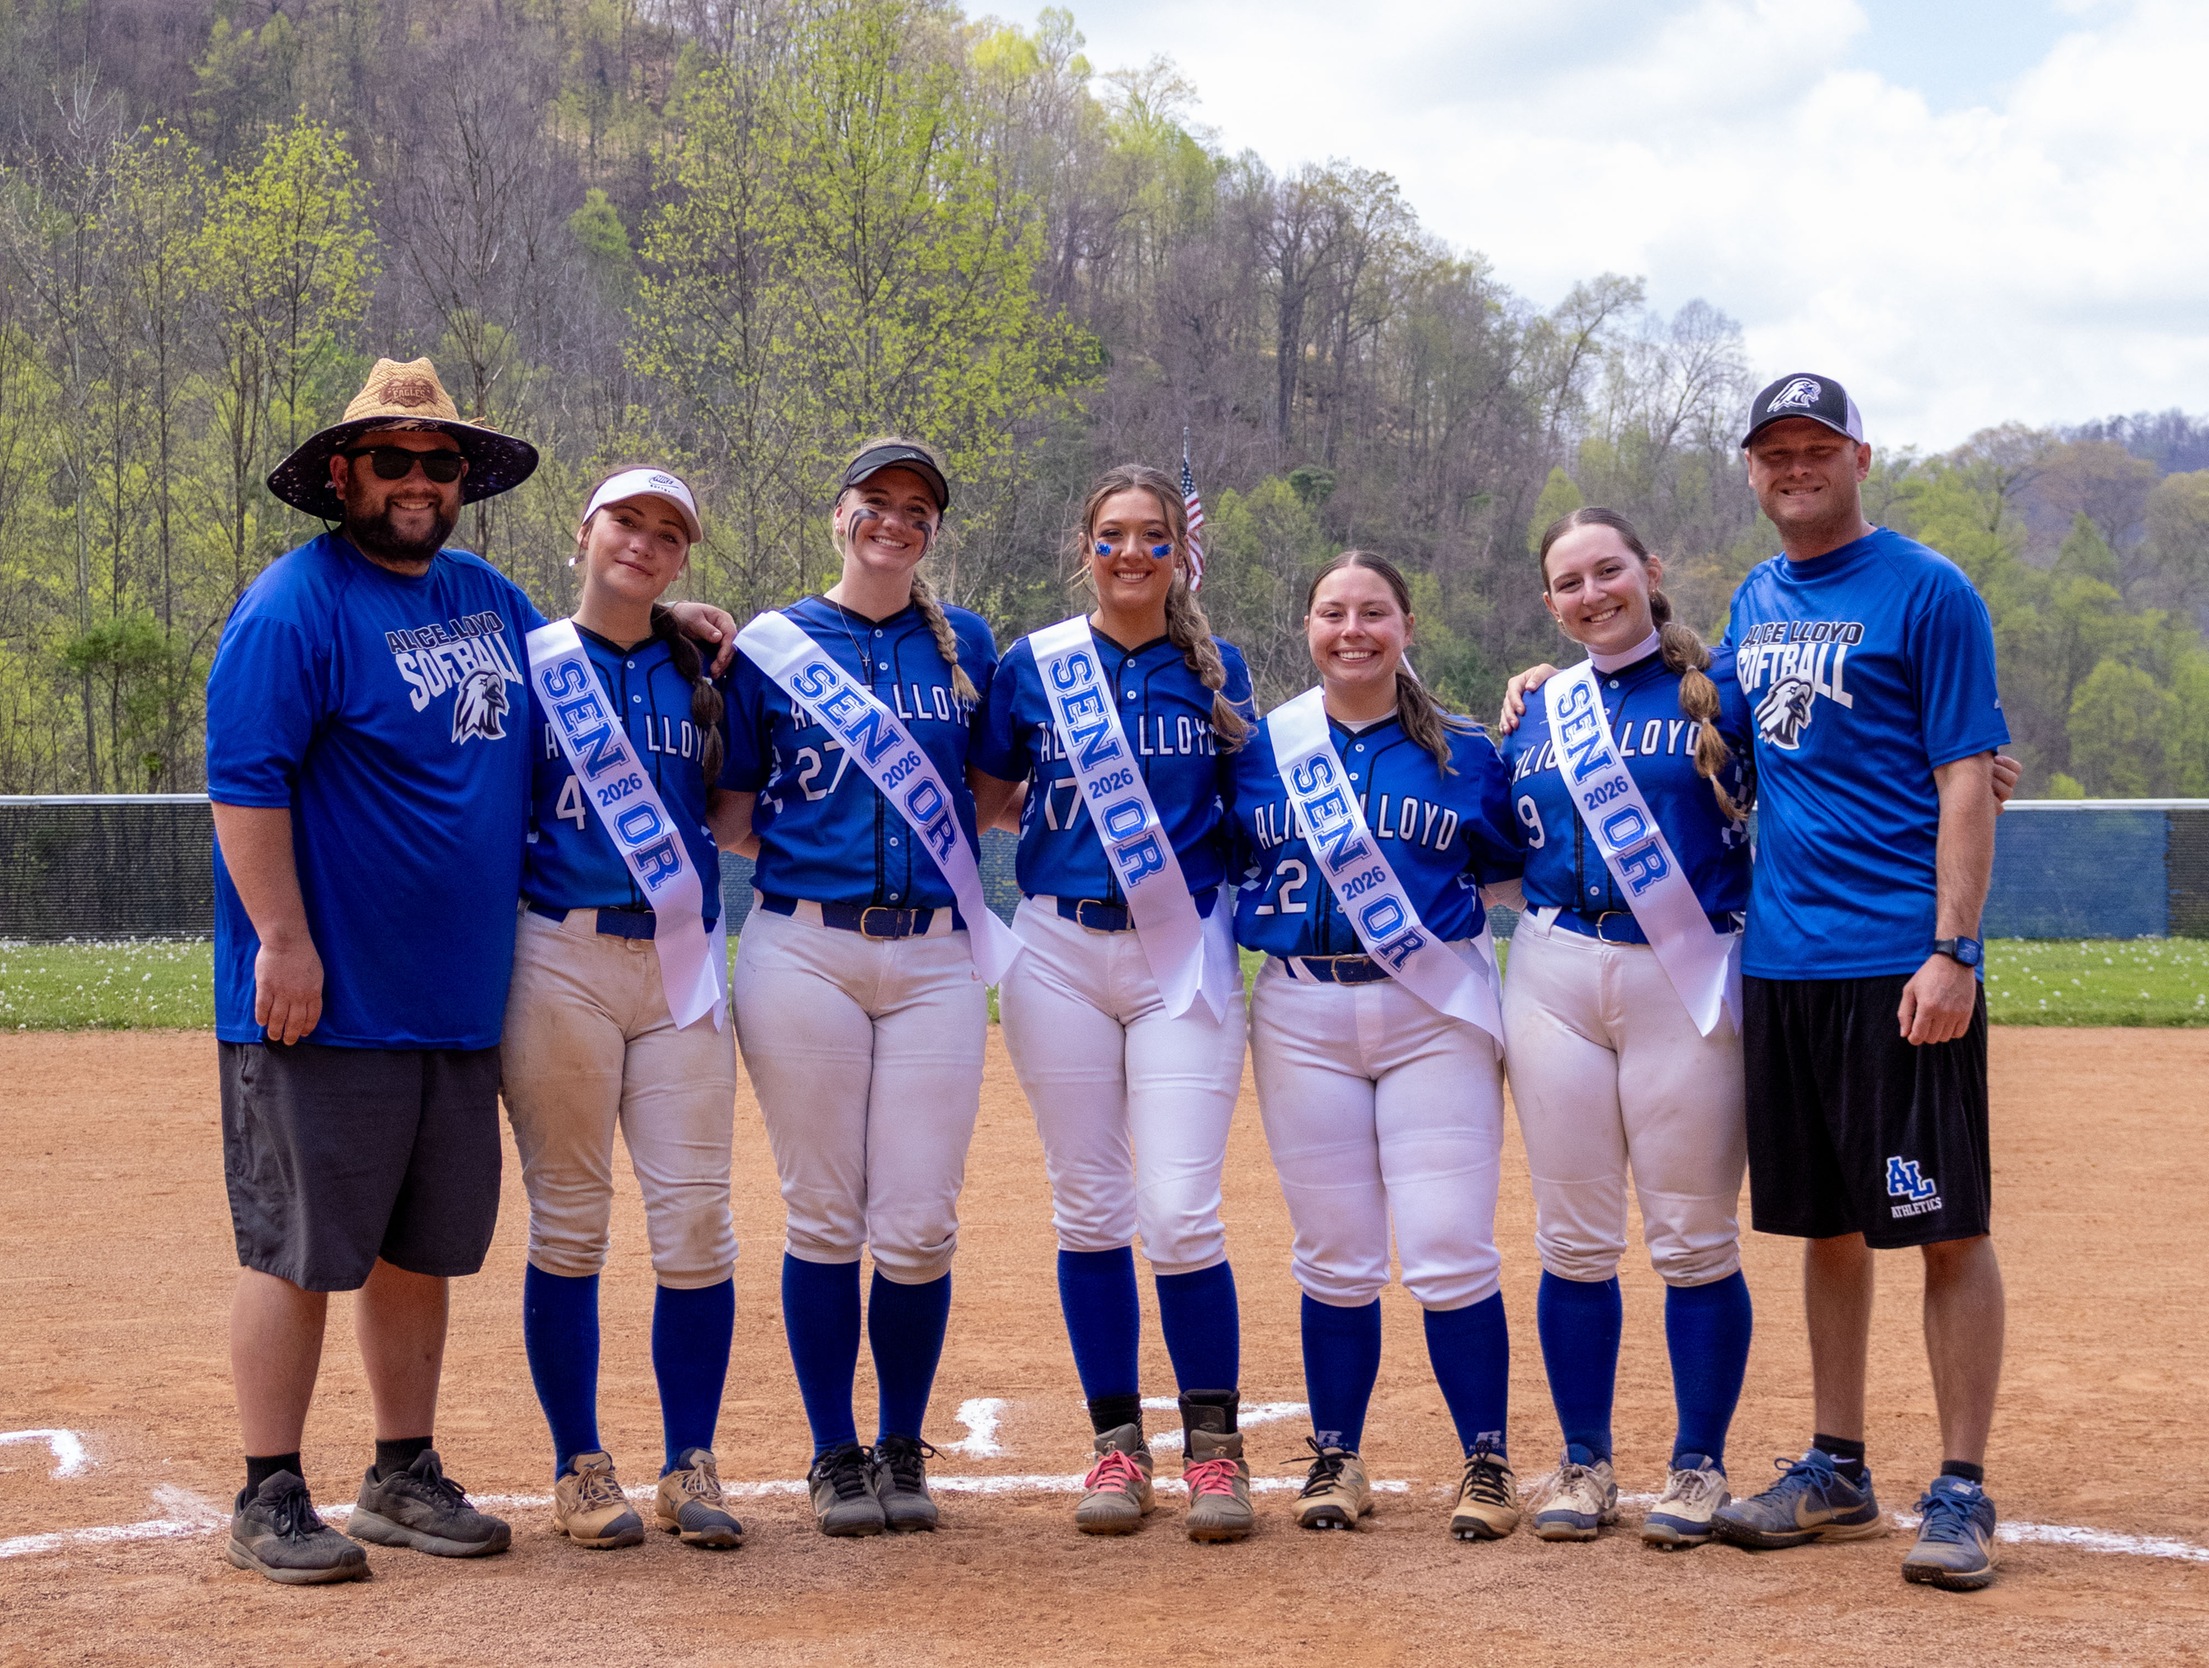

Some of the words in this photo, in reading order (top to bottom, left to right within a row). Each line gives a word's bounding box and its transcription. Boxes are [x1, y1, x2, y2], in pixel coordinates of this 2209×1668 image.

[393, 389, 426, 399] EAGLES
[385, 624, 450, 654] ALICE
[1739, 622, 1788, 648] ALICE
[1789, 620, 1865, 646] LLOYD
[646, 715, 707, 767] LLOY
[1512, 739, 1558, 786] ALI
[1609, 719, 1703, 757] LOYD
[597, 773, 643, 807] 2026
[795, 740, 850, 801] 27
[882, 751, 922, 790] 2026
[1088, 768, 1134, 799] 2026
[556, 775, 586, 830] 4
[1045, 777, 1083, 831] 17
[1583, 775, 1629, 811] 2026
[1255, 798, 1307, 850] ALI
[1517, 794, 1545, 850] 9
[1341, 865, 1386, 901] 2026
[1886, 1156, 1937, 1201] AL
[1890, 1197, 1943, 1219] ATHLETICS
